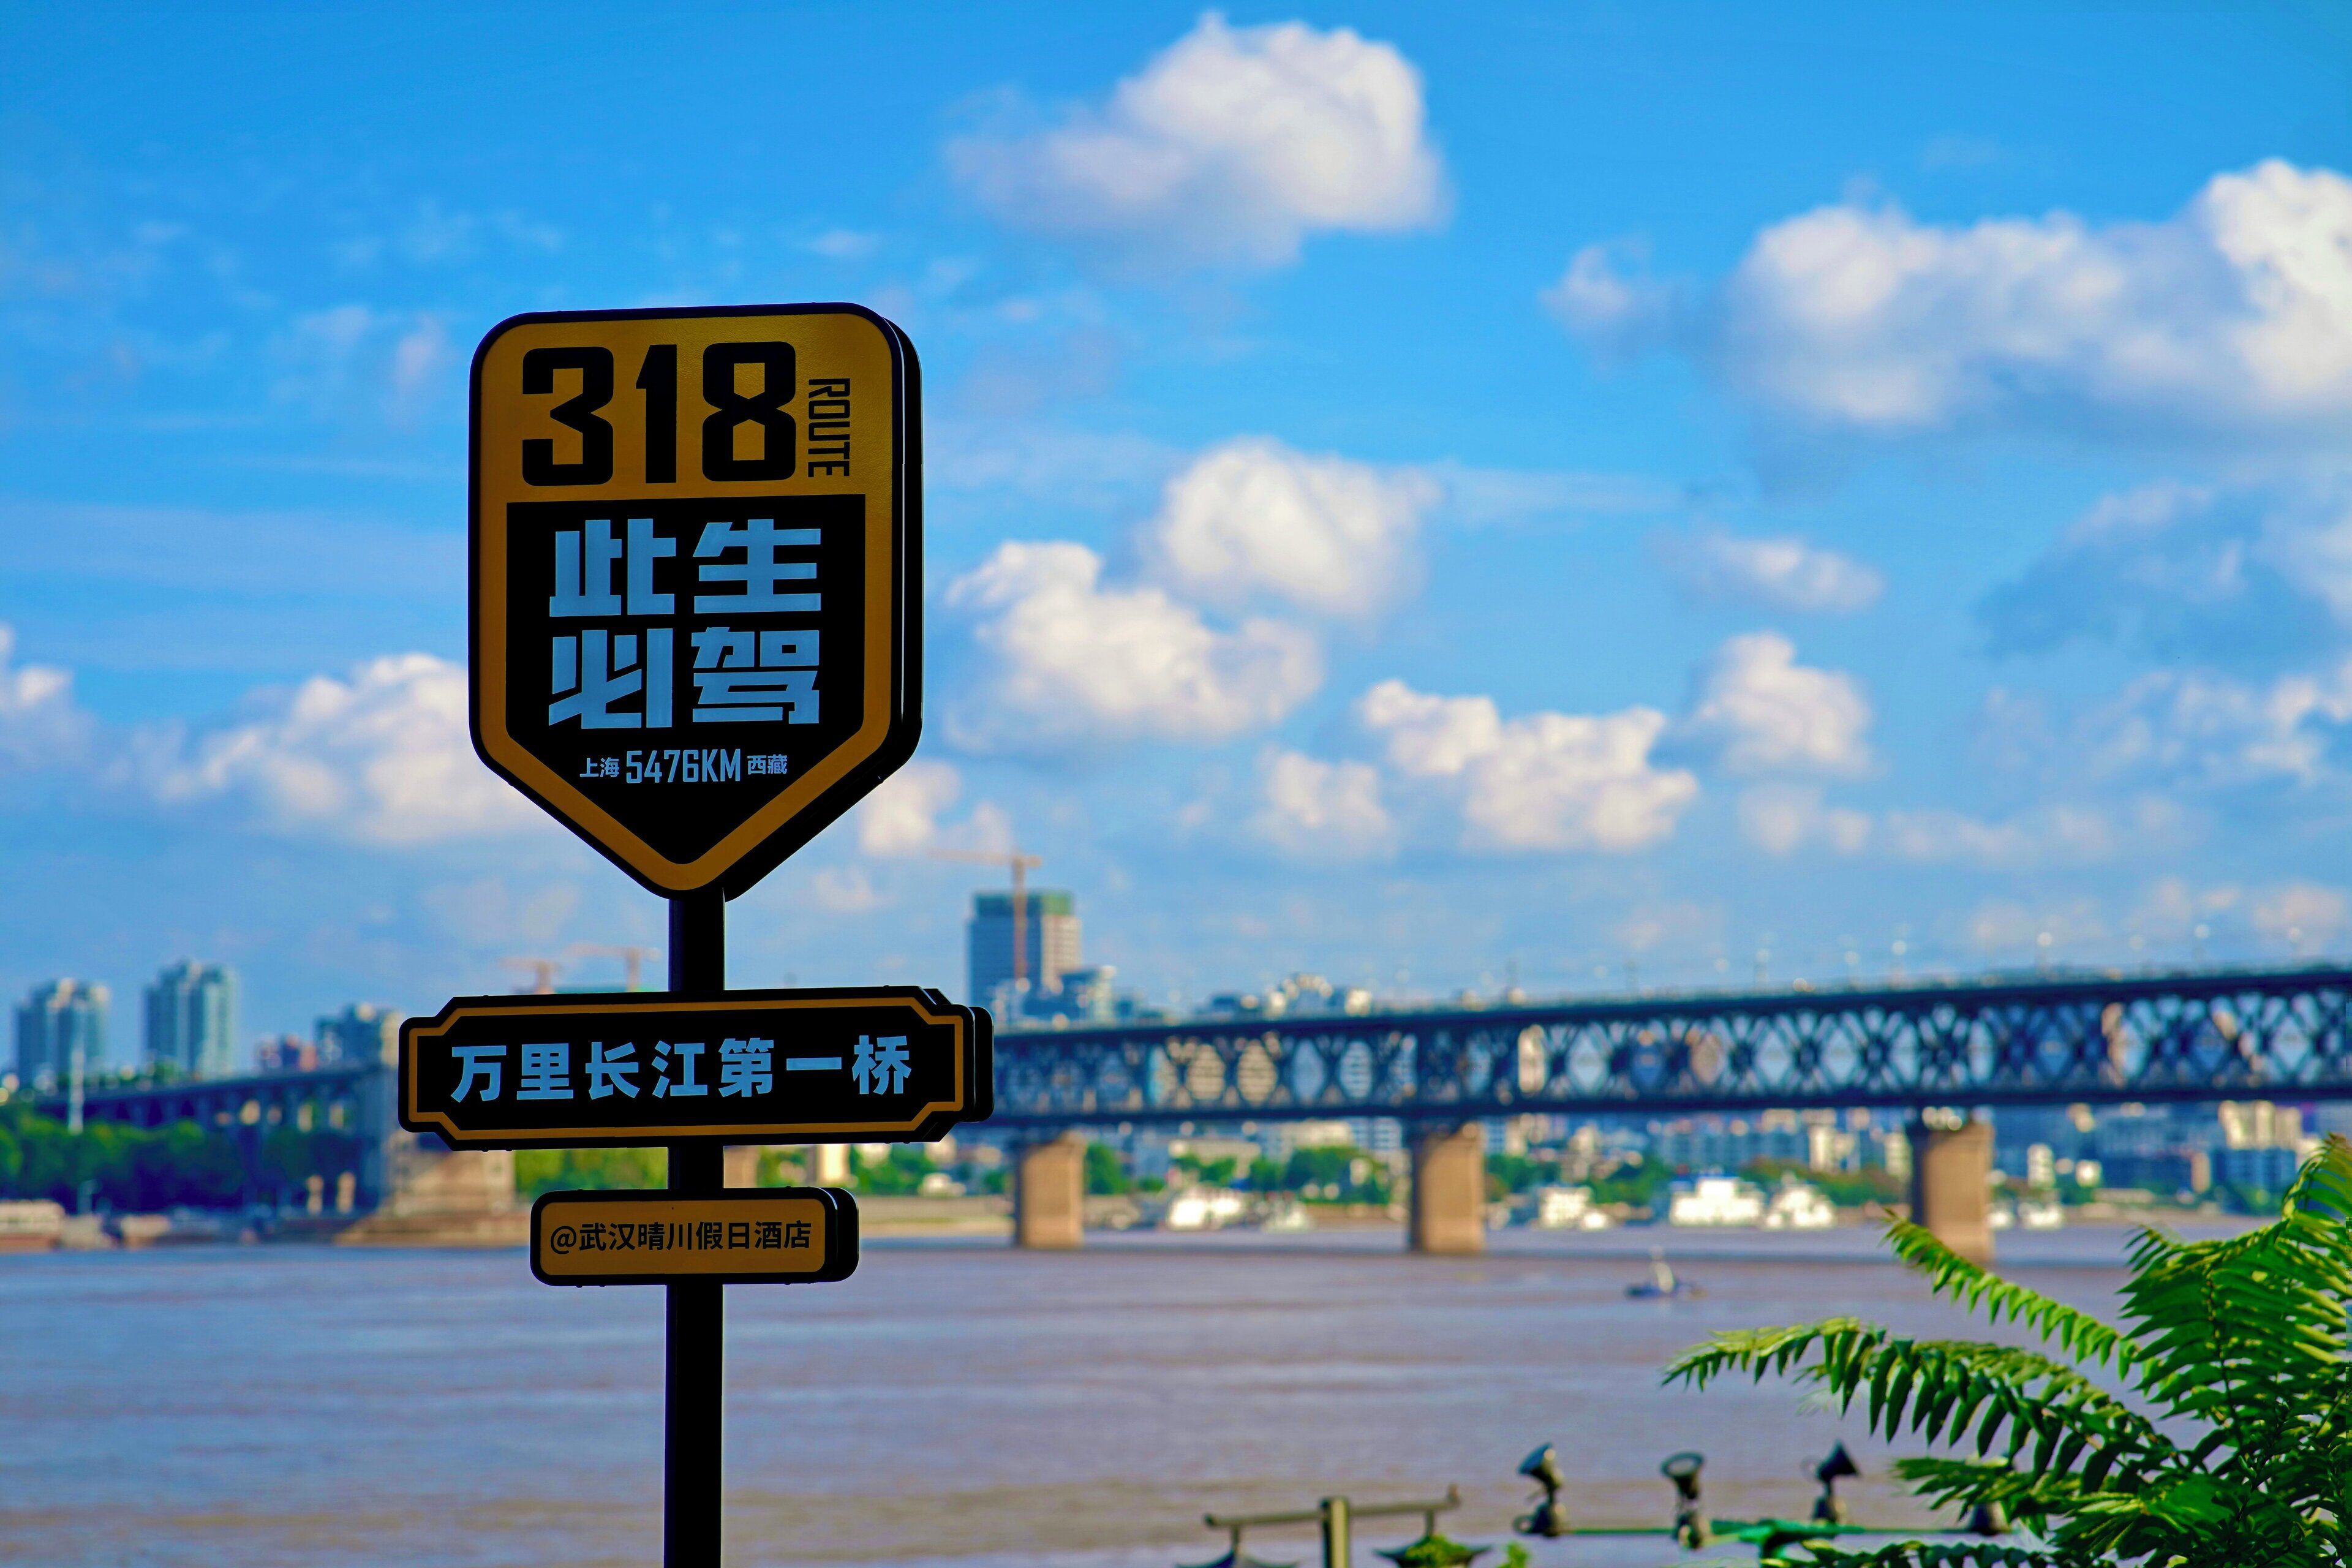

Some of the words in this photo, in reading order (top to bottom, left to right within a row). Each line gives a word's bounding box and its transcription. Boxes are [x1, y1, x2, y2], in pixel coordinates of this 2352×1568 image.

[522, 341, 796, 486] 318
[808, 378, 851, 478] ROUTE
[549, 518, 821, 617] 此生
[548, 627, 820, 729] 必驾
[579, 757, 620, 778] 上海
[626, 748, 741, 784] 5476KM
[747, 753, 788, 776] 西藏
[450, 1035, 912, 1103] 万里长江第一桥
[550, 1219, 812, 1255] @武汉晴川假日酒店
